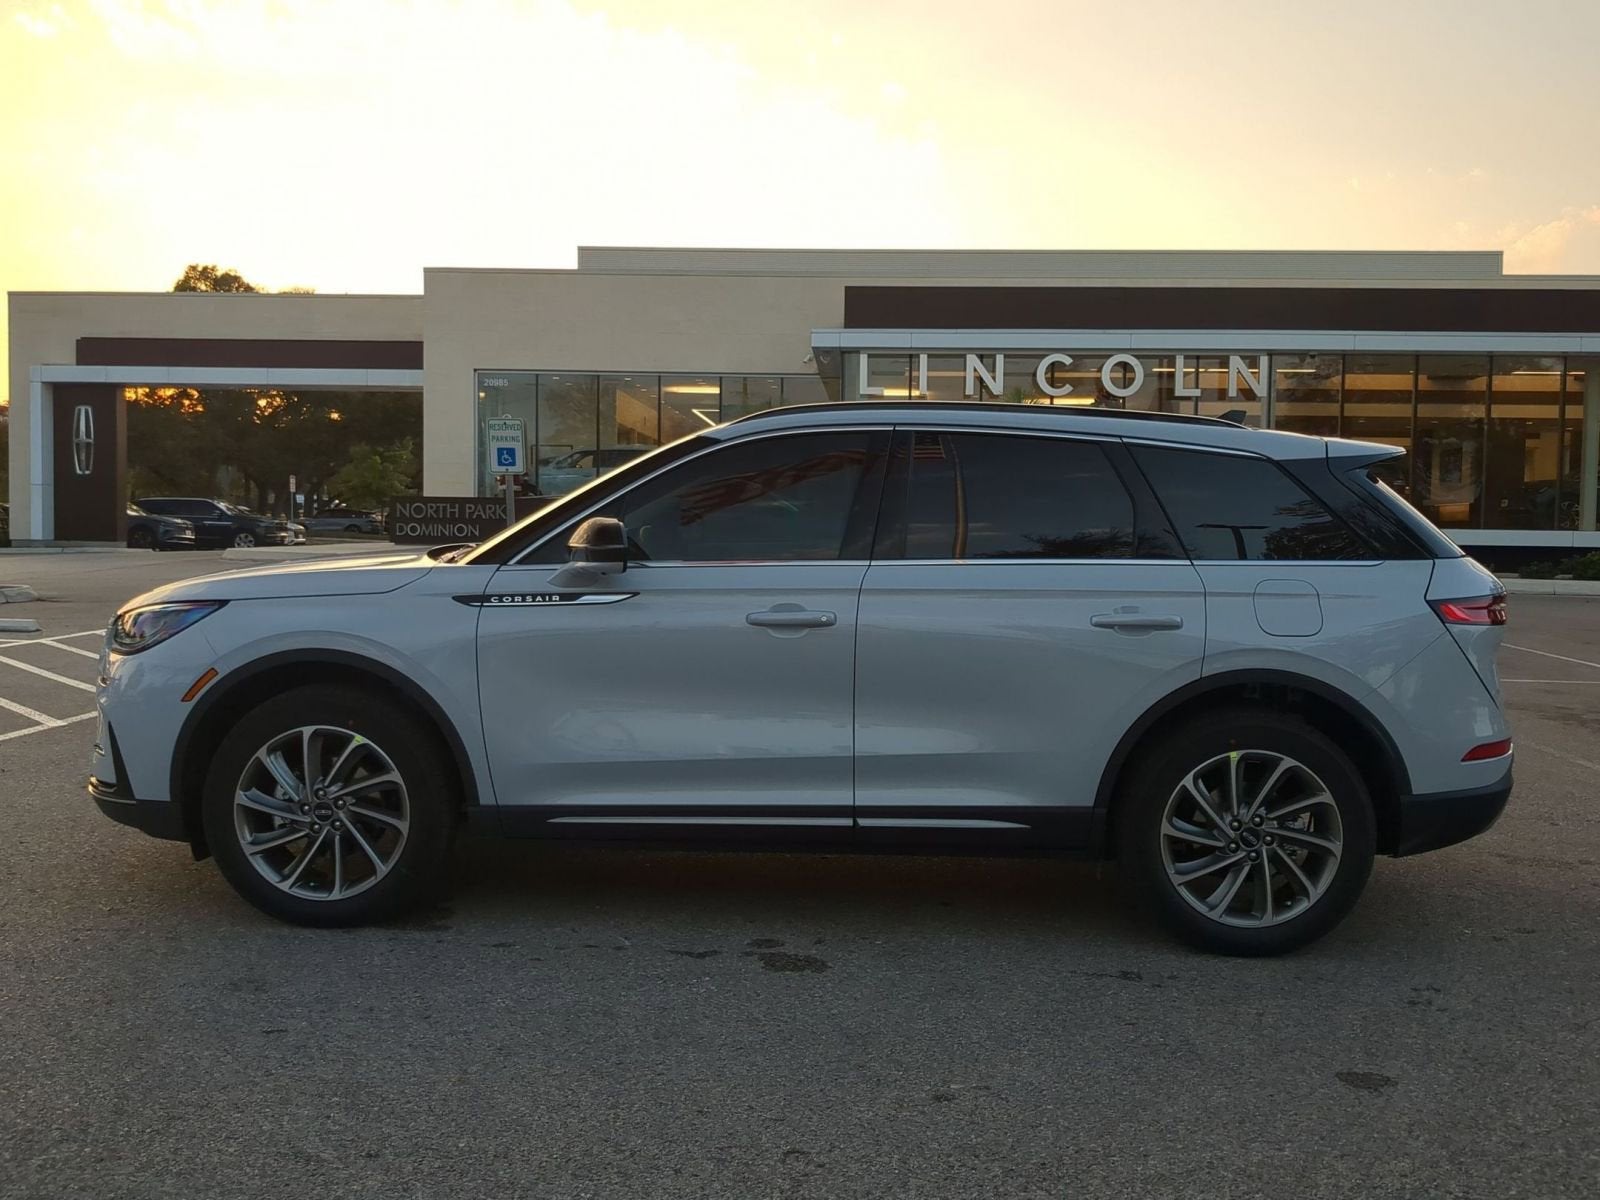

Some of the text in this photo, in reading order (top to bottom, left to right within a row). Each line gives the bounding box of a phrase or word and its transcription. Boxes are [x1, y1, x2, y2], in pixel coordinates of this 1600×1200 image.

[859, 353, 1269, 398] LINCOLN
[489, 423, 521, 432] RESERVED
[491, 435, 520, 443] PARKING
[396, 502, 506, 519] NORTH PARK
[396, 523, 479, 537] DOMINION
[490, 595, 560, 603] CORSAIR
